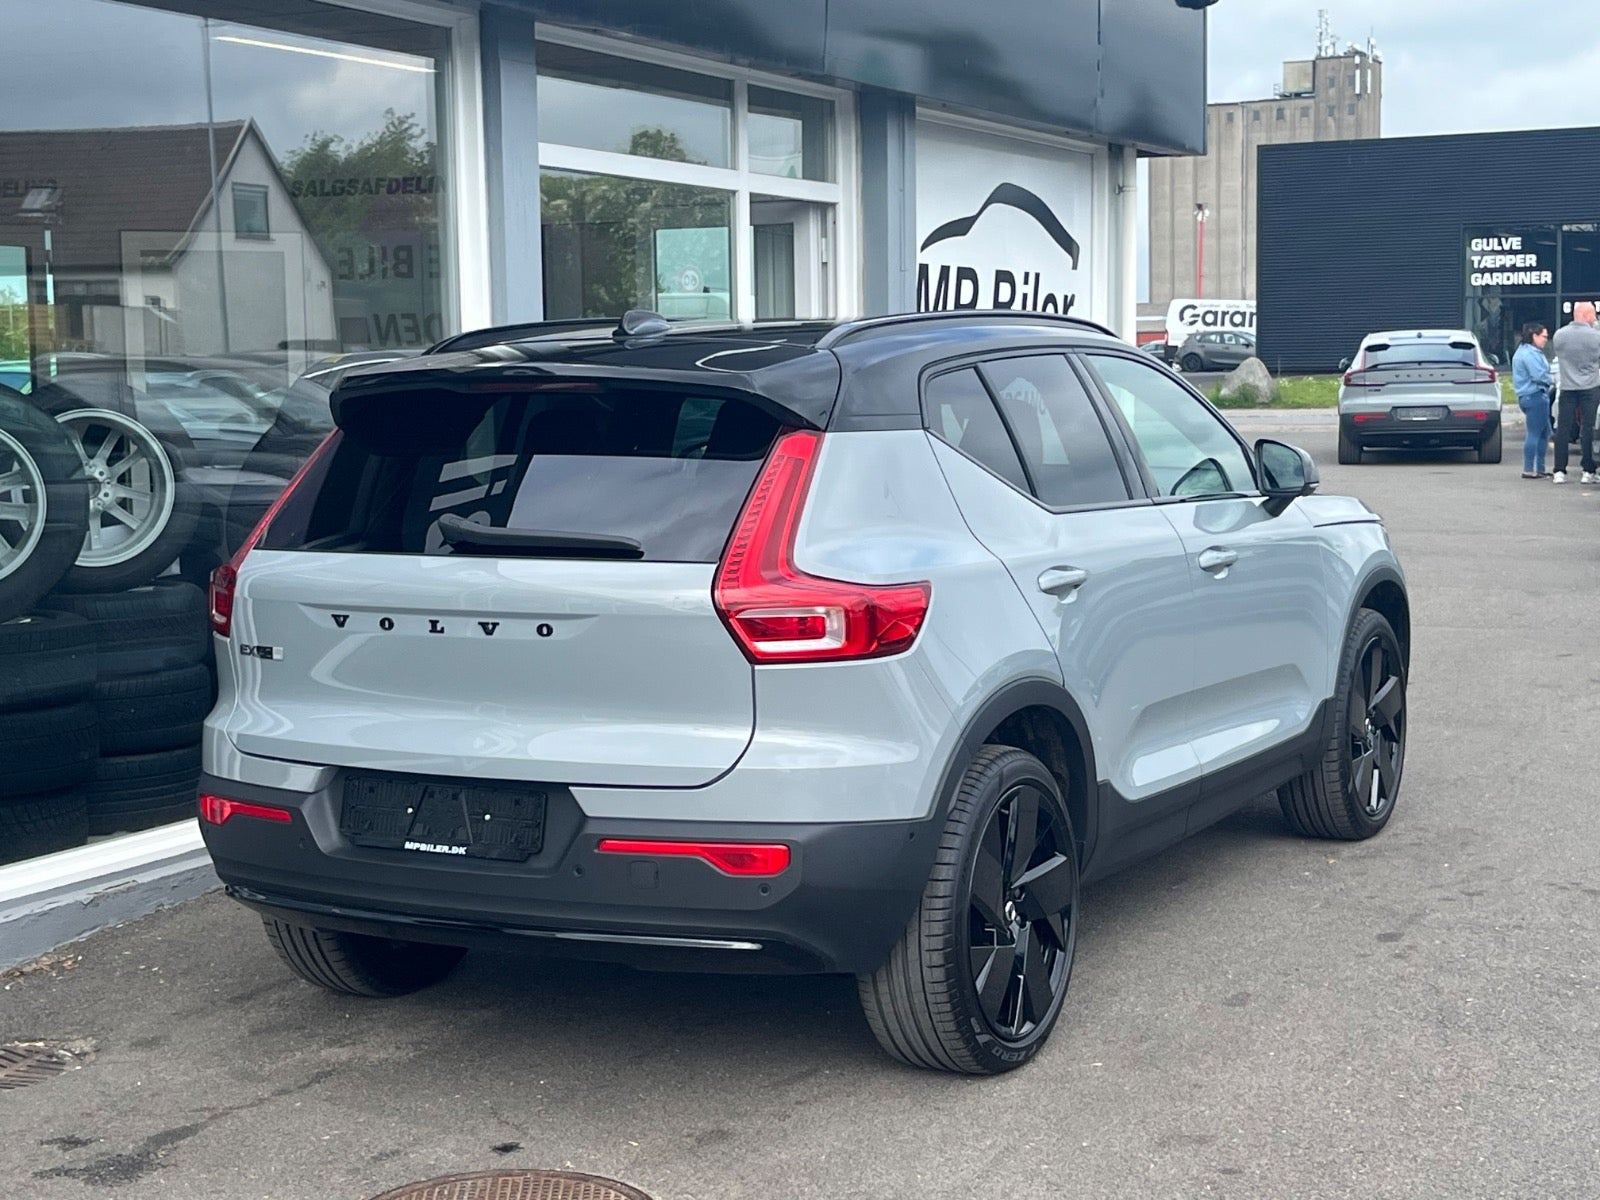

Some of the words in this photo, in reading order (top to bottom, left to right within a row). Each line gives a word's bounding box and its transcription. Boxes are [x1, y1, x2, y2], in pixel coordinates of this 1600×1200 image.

[1471, 237, 1522, 251] GULVE
[1471, 254, 1537, 268] TÆPPER
[1470, 271, 1552, 286] GARDINER
[331, 613, 554, 638] VOLVO
[404, 841, 467, 855] MPBILER.DK
